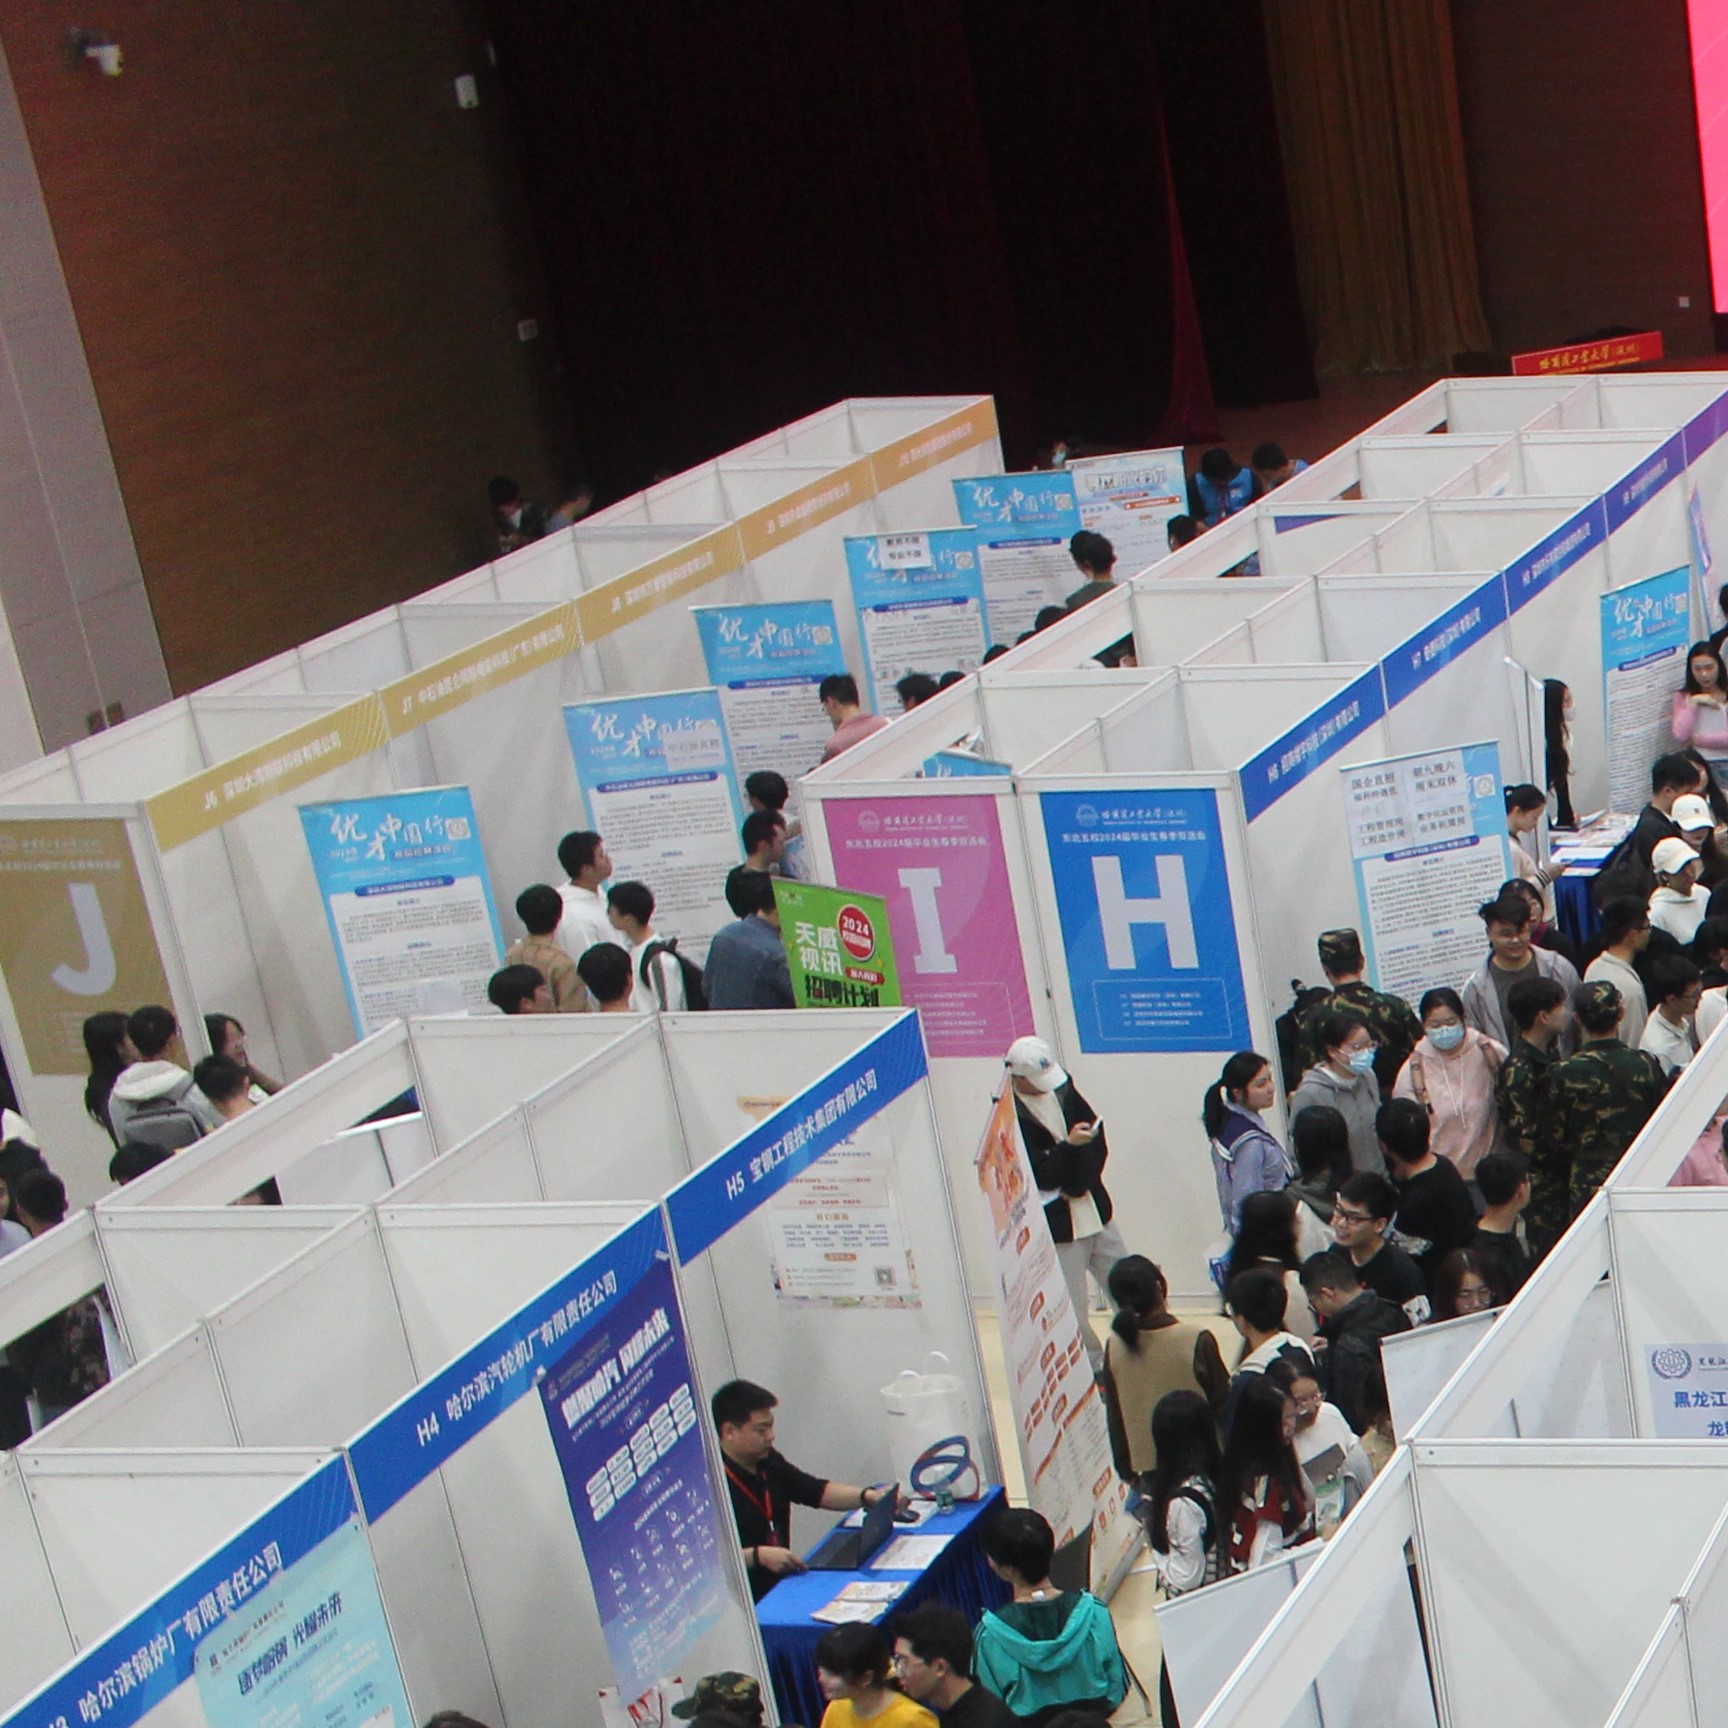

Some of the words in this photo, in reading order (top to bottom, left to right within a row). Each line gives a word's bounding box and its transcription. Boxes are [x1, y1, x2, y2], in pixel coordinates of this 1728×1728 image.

[51, 882, 117, 996] J
[795, 920, 838, 951] 天威
[843, 917, 869, 936] 2024
[1091, 855, 1199, 970] H
[800, 946, 844, 976] 视讯
[726, 1170, 746, 1200] H5
[416, 1416, 440, 1447] H4
[446, 1269, 619, 1422] 哈尔滨汽轮机厂有限责任公司
[78, 1542, 285, 1725] 哈尔滨锅炉厂有限责任公司
